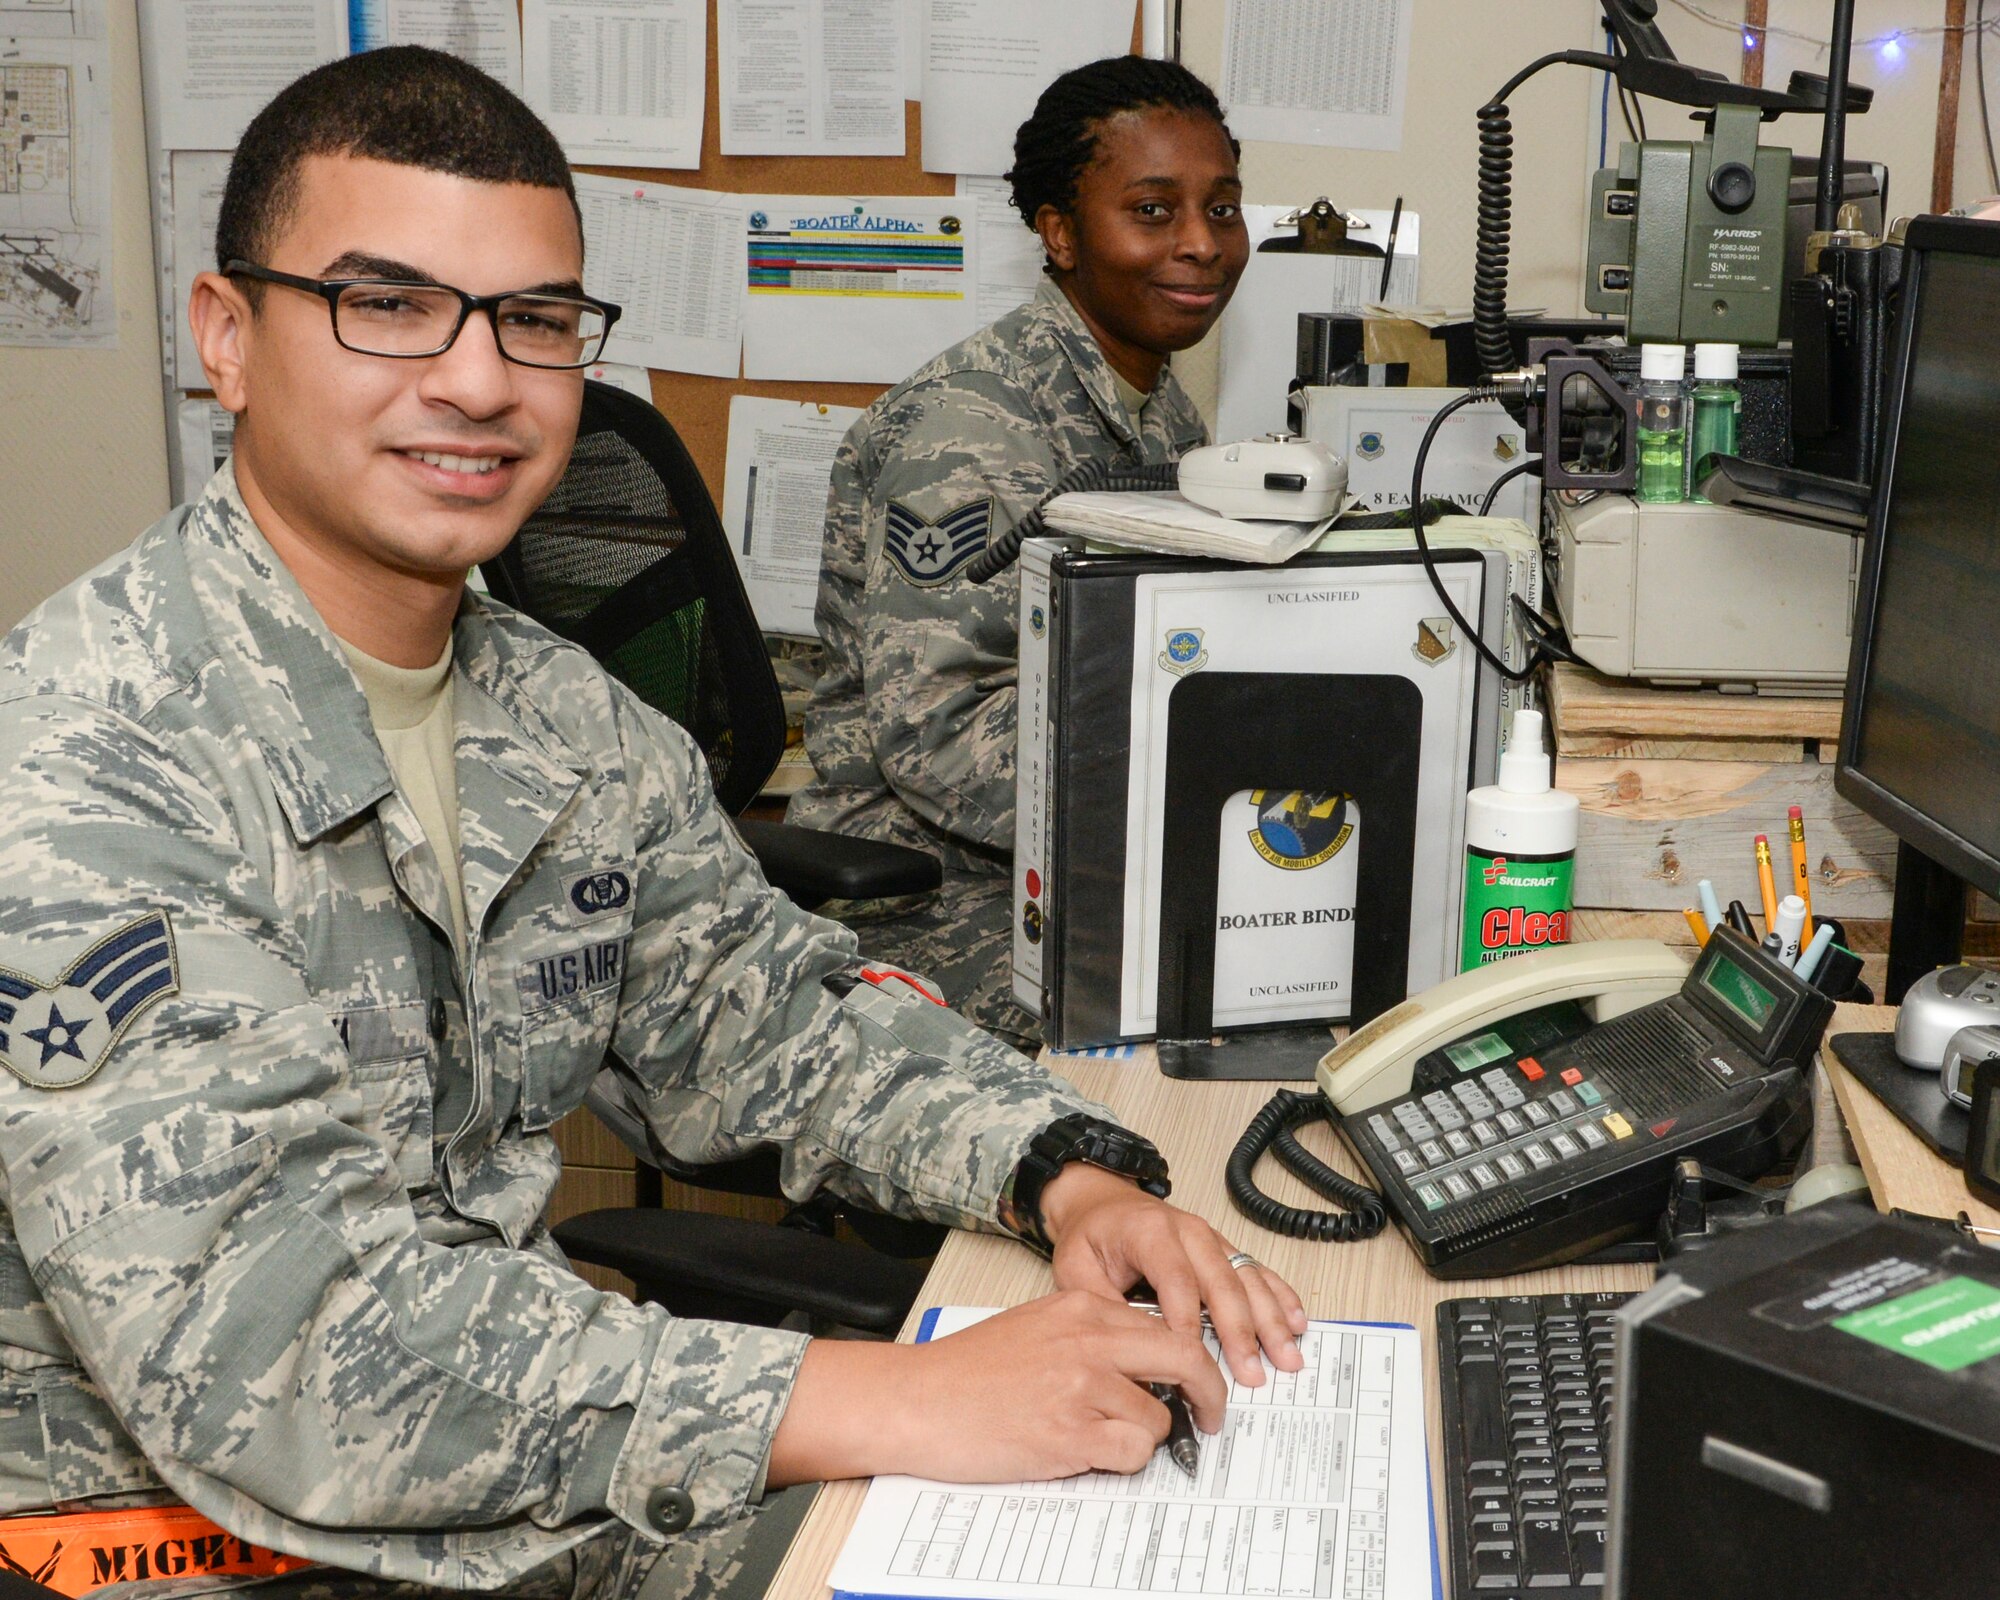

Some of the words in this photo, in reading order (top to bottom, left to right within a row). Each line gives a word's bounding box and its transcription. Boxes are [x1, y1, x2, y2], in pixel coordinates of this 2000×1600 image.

[790, 214, 860, 230] "BOATER
[864, 215, 924, 233] ALPHA"
[1710, 262, 1729, 272] SN:
[1374, 492, 1382, 505] 8
[1267, 591, 1360, 604] UNCLASSIFIED
[1269, 854, 1282, 865] AIR
[1282, 857, 1318, 869] MOBILITY
[1319, 826, 1350, 862] SQUADRON
[1498, 876, 1557, 887] SKILCRAFT
[1219, 911, 1297, 930] BOATER
[1481, 907, 1570, 950] Clea
[1250, 980, 1339, 997] UNCLASSIFIED
[90, 1533, 288, 1585] MIGHT
[1323, 1539, 1332, 1566] OUTBOUND
